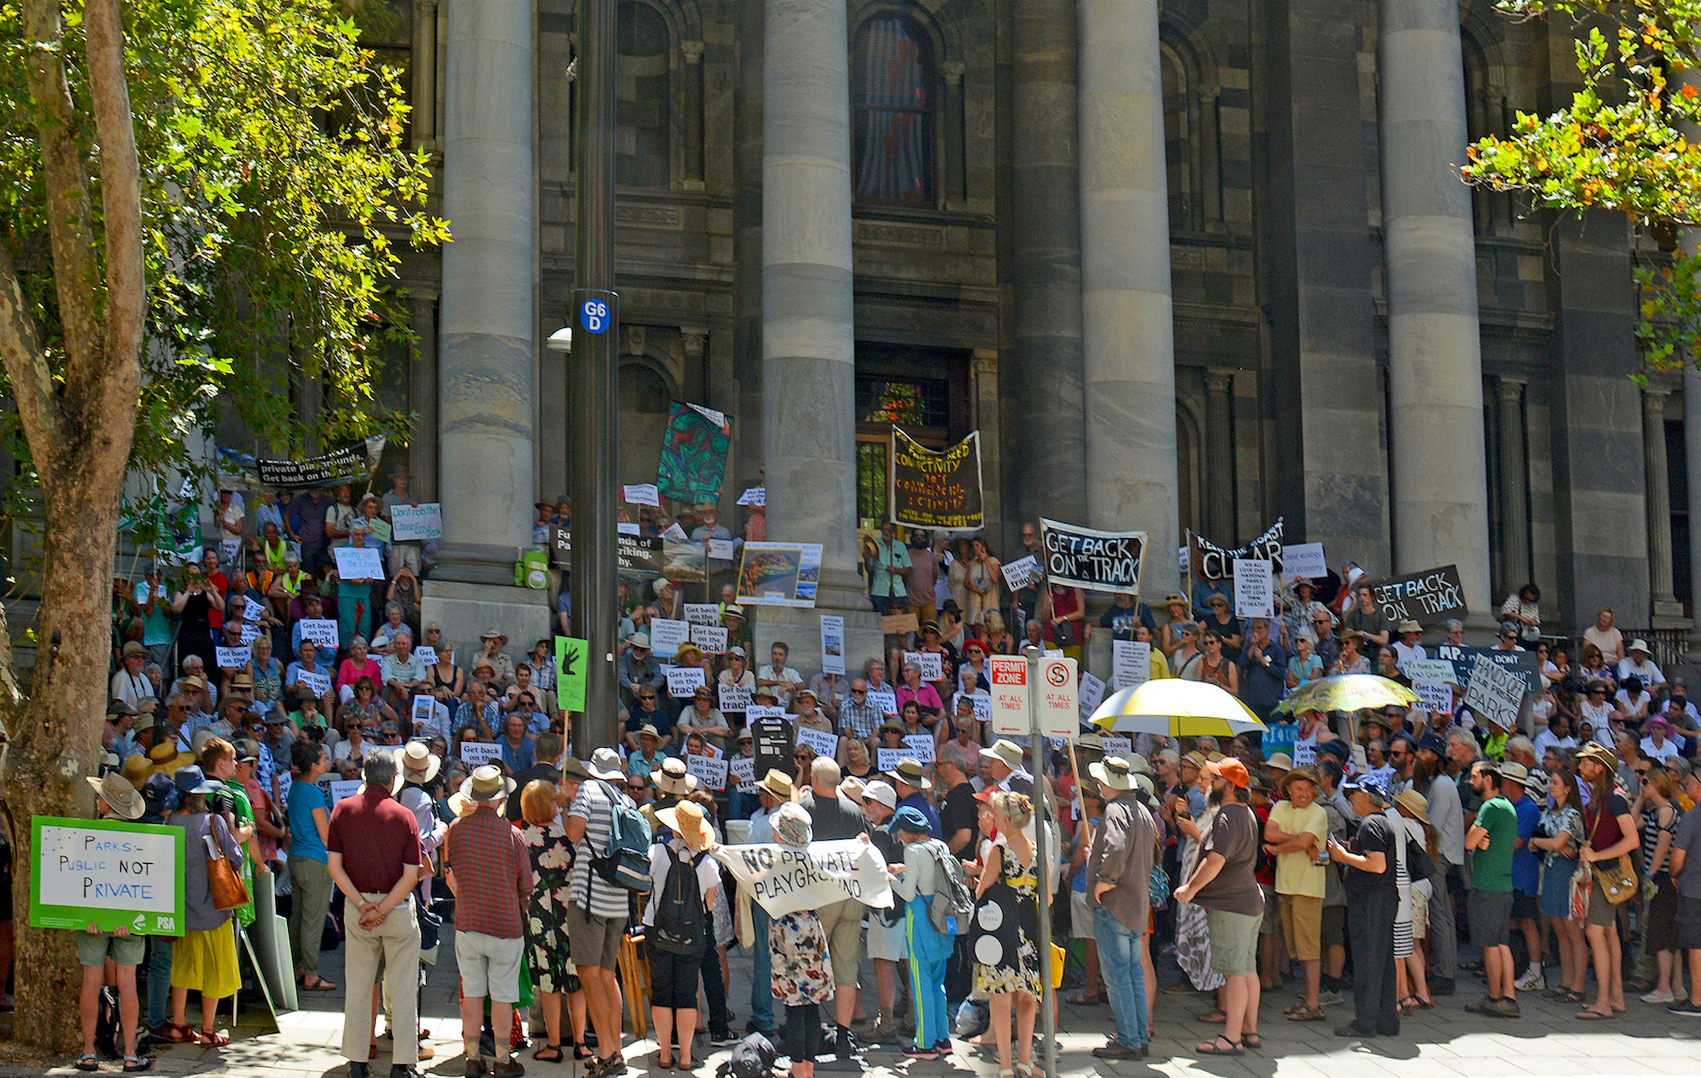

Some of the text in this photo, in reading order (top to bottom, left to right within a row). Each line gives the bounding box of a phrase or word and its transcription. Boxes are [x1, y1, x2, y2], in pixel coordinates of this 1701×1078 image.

[585, 302, 606, 317] G6
[590, 316, 600, 330] D
[263, 474, 280, 482] Get
[282, 473, 304, 482] back
[321, 470, 334, 478] th
[618, 536, 651, 547] nds of
[1046, 532, 1132, 558] GET BACK
[618, 547, 652, 560] riking.
[618, 556, 632, 567] hy.
[1203, 541, 1284, 580] CLAR
[1050, 554, 1077, 575] ON
[1090, 556, 1138, 582] TRACK
[1374, 572, 1453, 604] GET BACK
[1382, 585, 1464, 621] ON TRACK
[1439, 646, 1465, 661] MPs
[993, 661, 1026, 672] PERMIT
[314, 676, 328, 684] back
[996, 673, 1022, 684] ZONE
[1474, 675, 1488, 689] OUR
[1415, 683, 1450, 695] Get back
[1001, 702, 1021, 710] TIMES
[1049, 701, 1070, 709] TIMES
[1468, 687, 1517, 728] PARKS
[815, 740, 829, 749] the
[816, 733, 834, 744] back
[464, 745, 500, 754] Get back
[815, 748, 832, 758] ck!
[690, 758, 725, 770] Get back
[734, 764, 748, 772] Get
[707, 768, 719, 776] the
[698, 776, 723, 787] ack!
[60, 855, 154, 876] PUBLIC NOT
[741, 847, 860, 874] NO PRIVATE
[83, 877, 153, 900] PRIVATE
[754, 869, 862, 900] PLAYGRND
[157, 916, 175, 930] PSA
